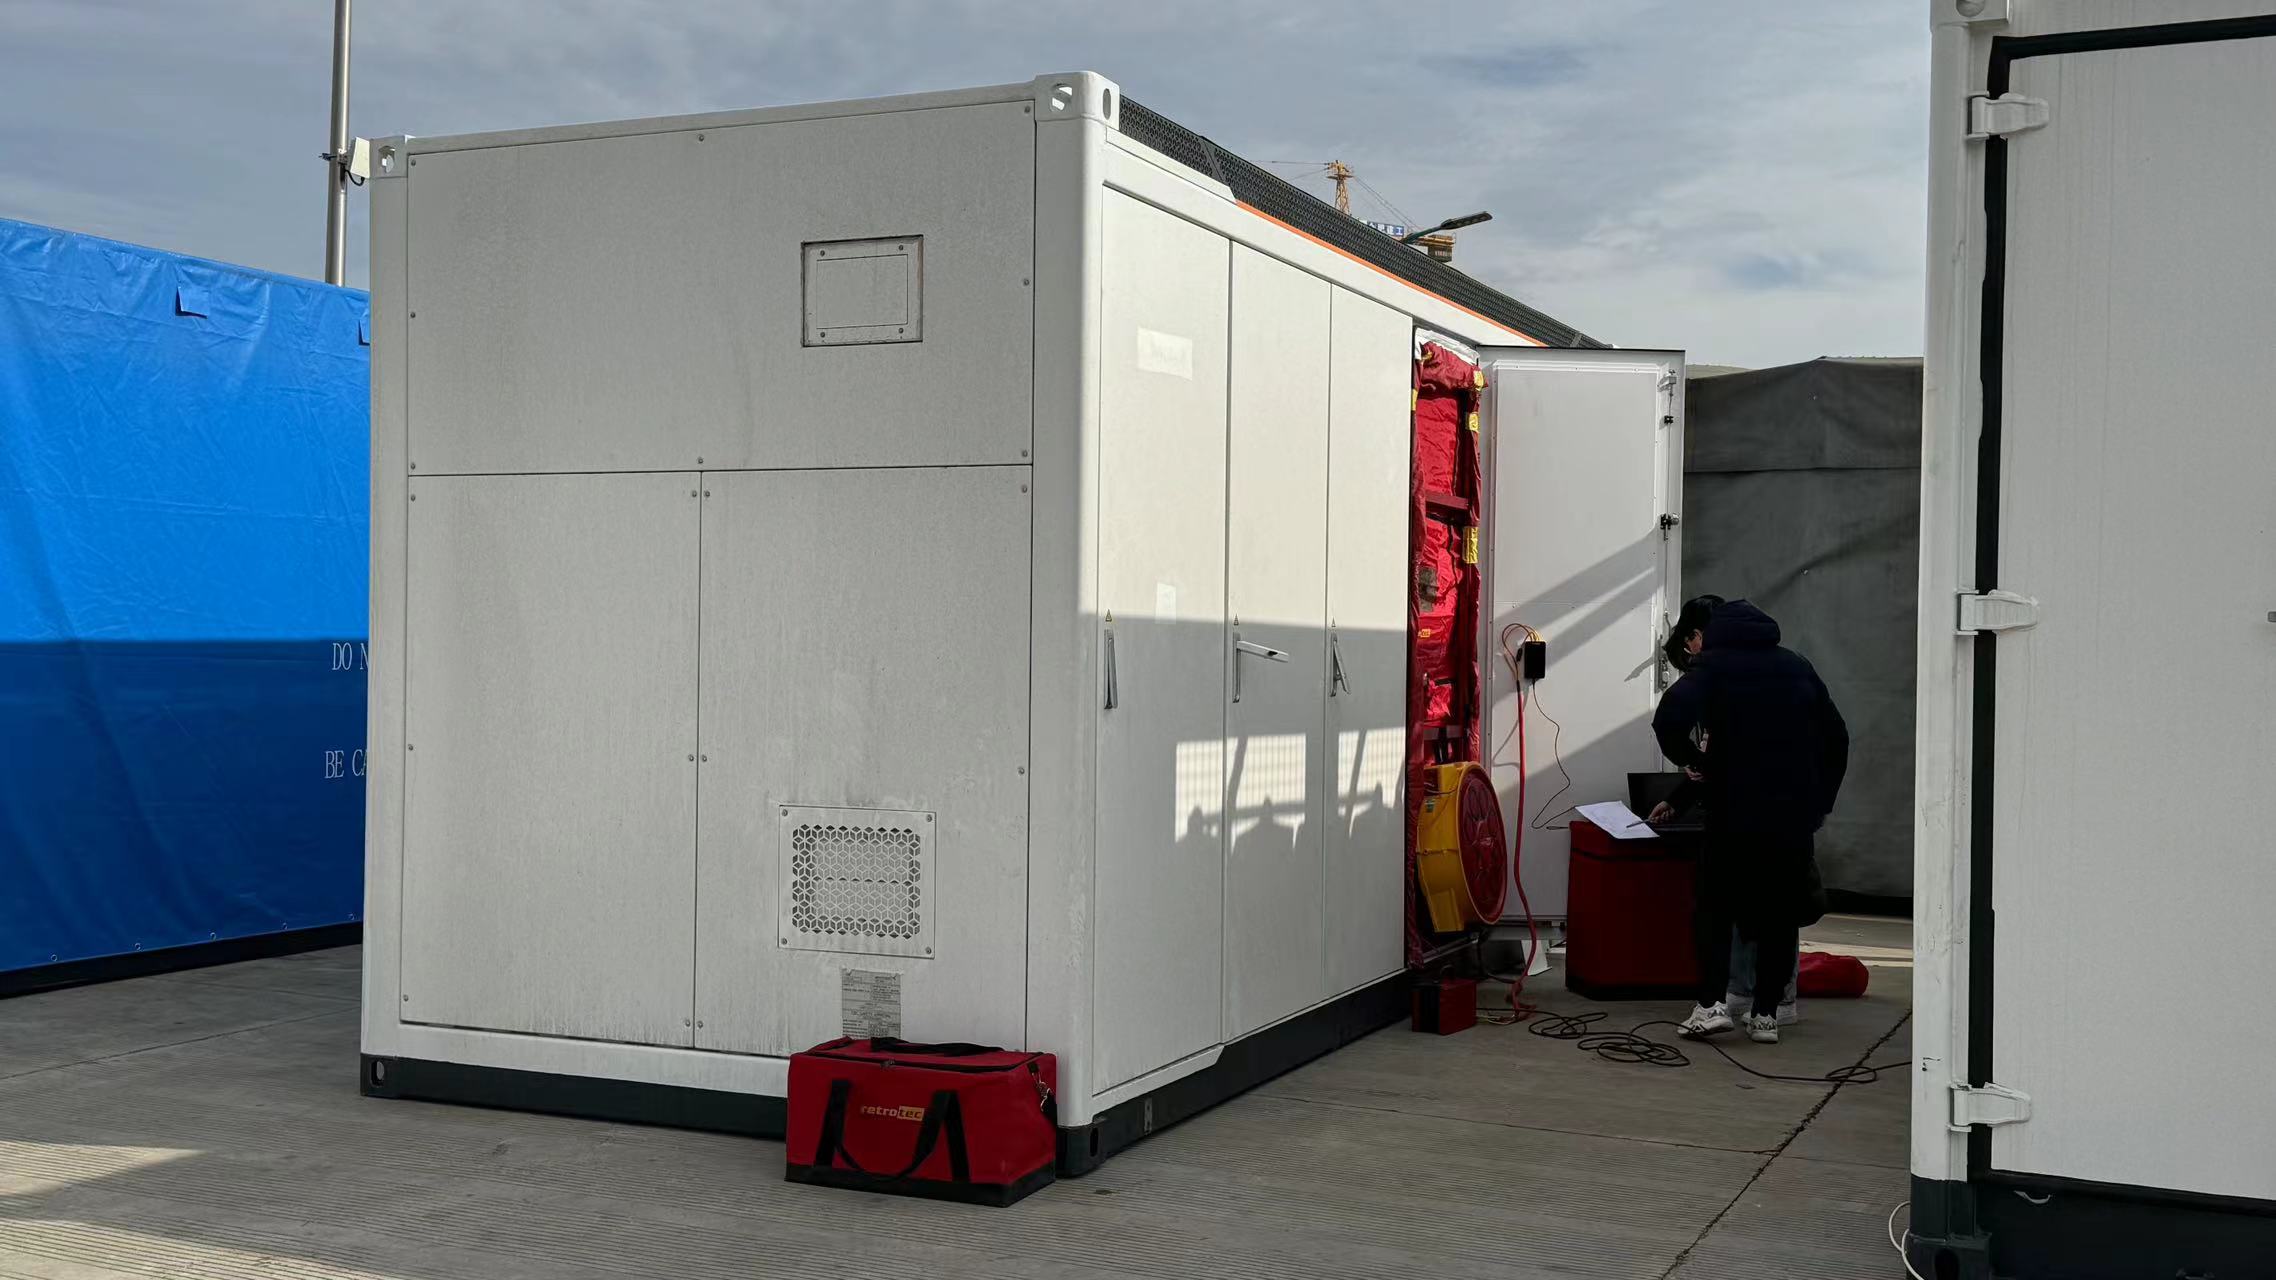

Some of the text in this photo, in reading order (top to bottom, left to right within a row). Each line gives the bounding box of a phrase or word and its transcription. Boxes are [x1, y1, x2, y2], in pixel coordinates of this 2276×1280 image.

[331, 642, 353, 671] DO
[324, 750, 345, 779] BE
[860, 1105, 924, 1121] retrotec
